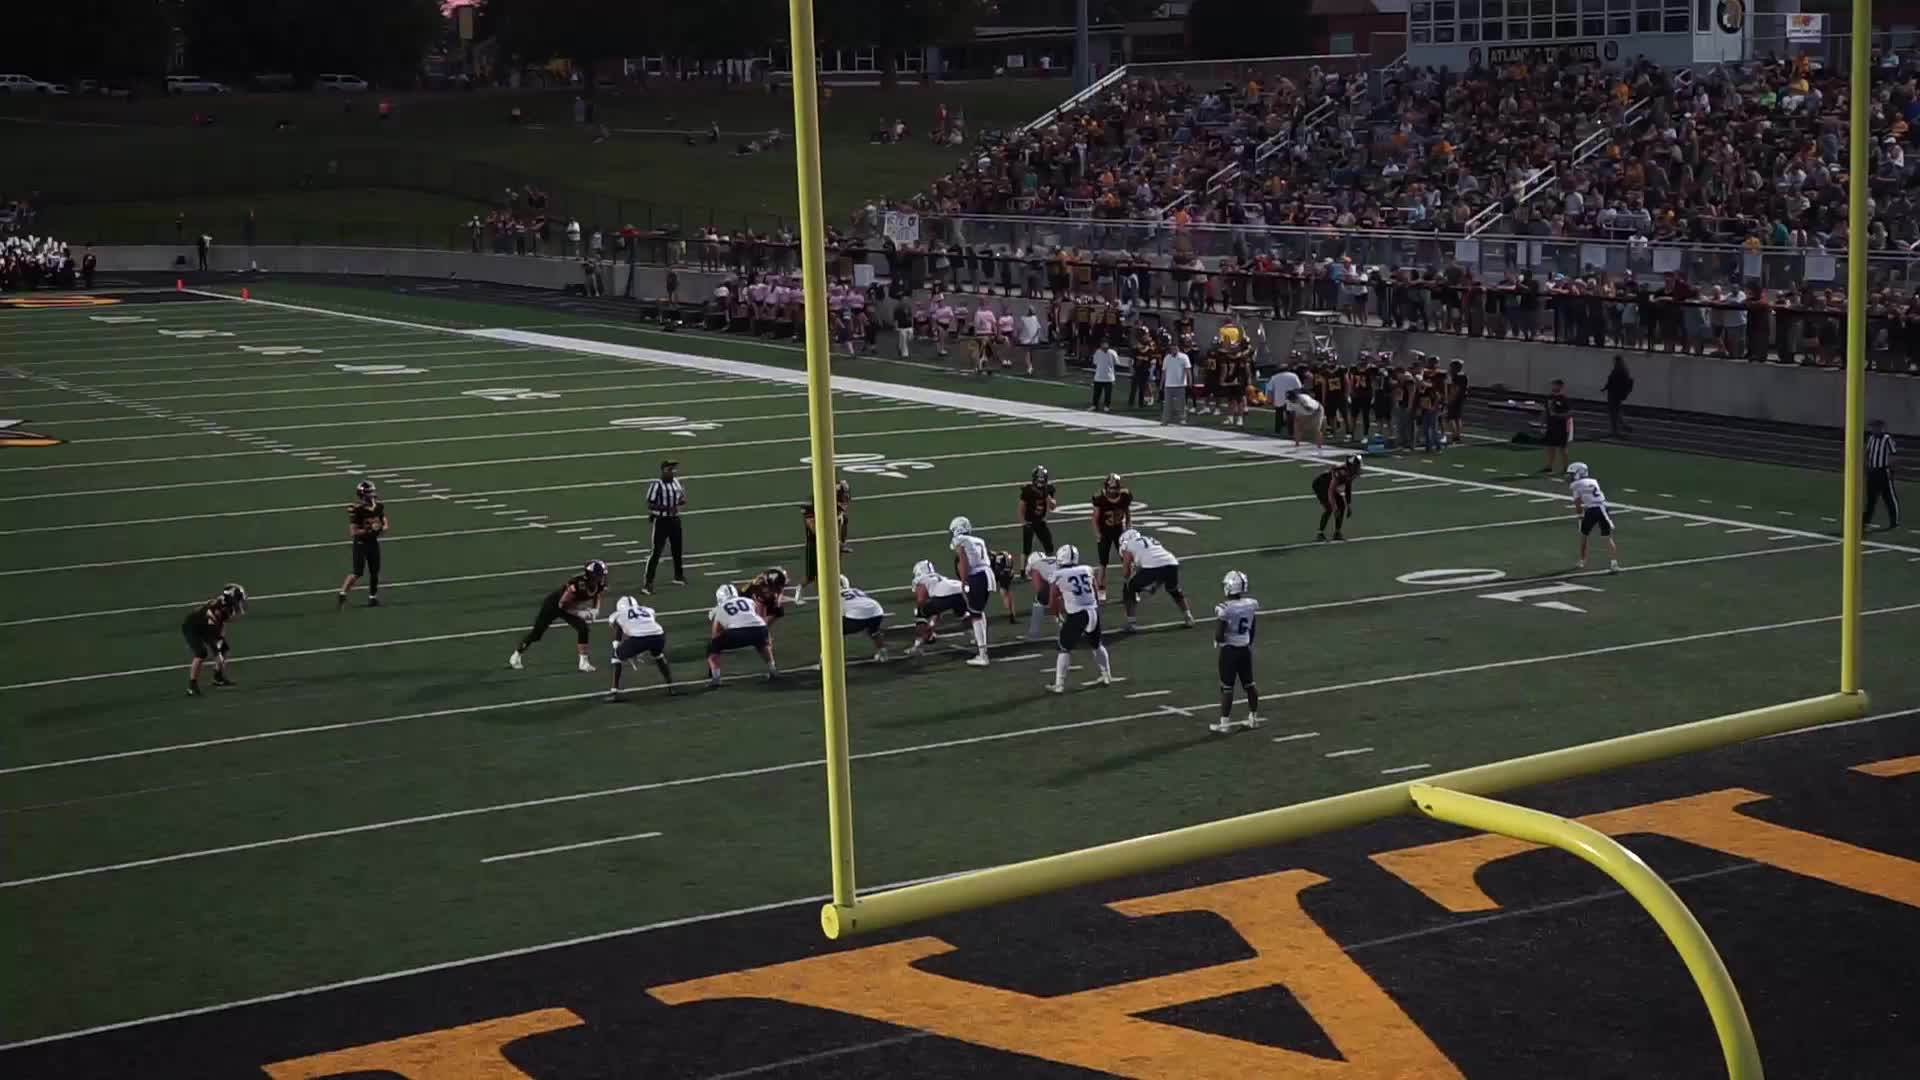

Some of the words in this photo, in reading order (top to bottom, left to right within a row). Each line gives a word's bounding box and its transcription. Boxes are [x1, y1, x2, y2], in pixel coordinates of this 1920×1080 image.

[1587, 485, 1600, 498] 2
[974, 542, 985, 560] 7
[1067, 573, 1092, 597] 35
[1395, 567, 1606, 604] 10
[724, 599, 750, 617] 60
[1238, 617, 1250, 635] 6
